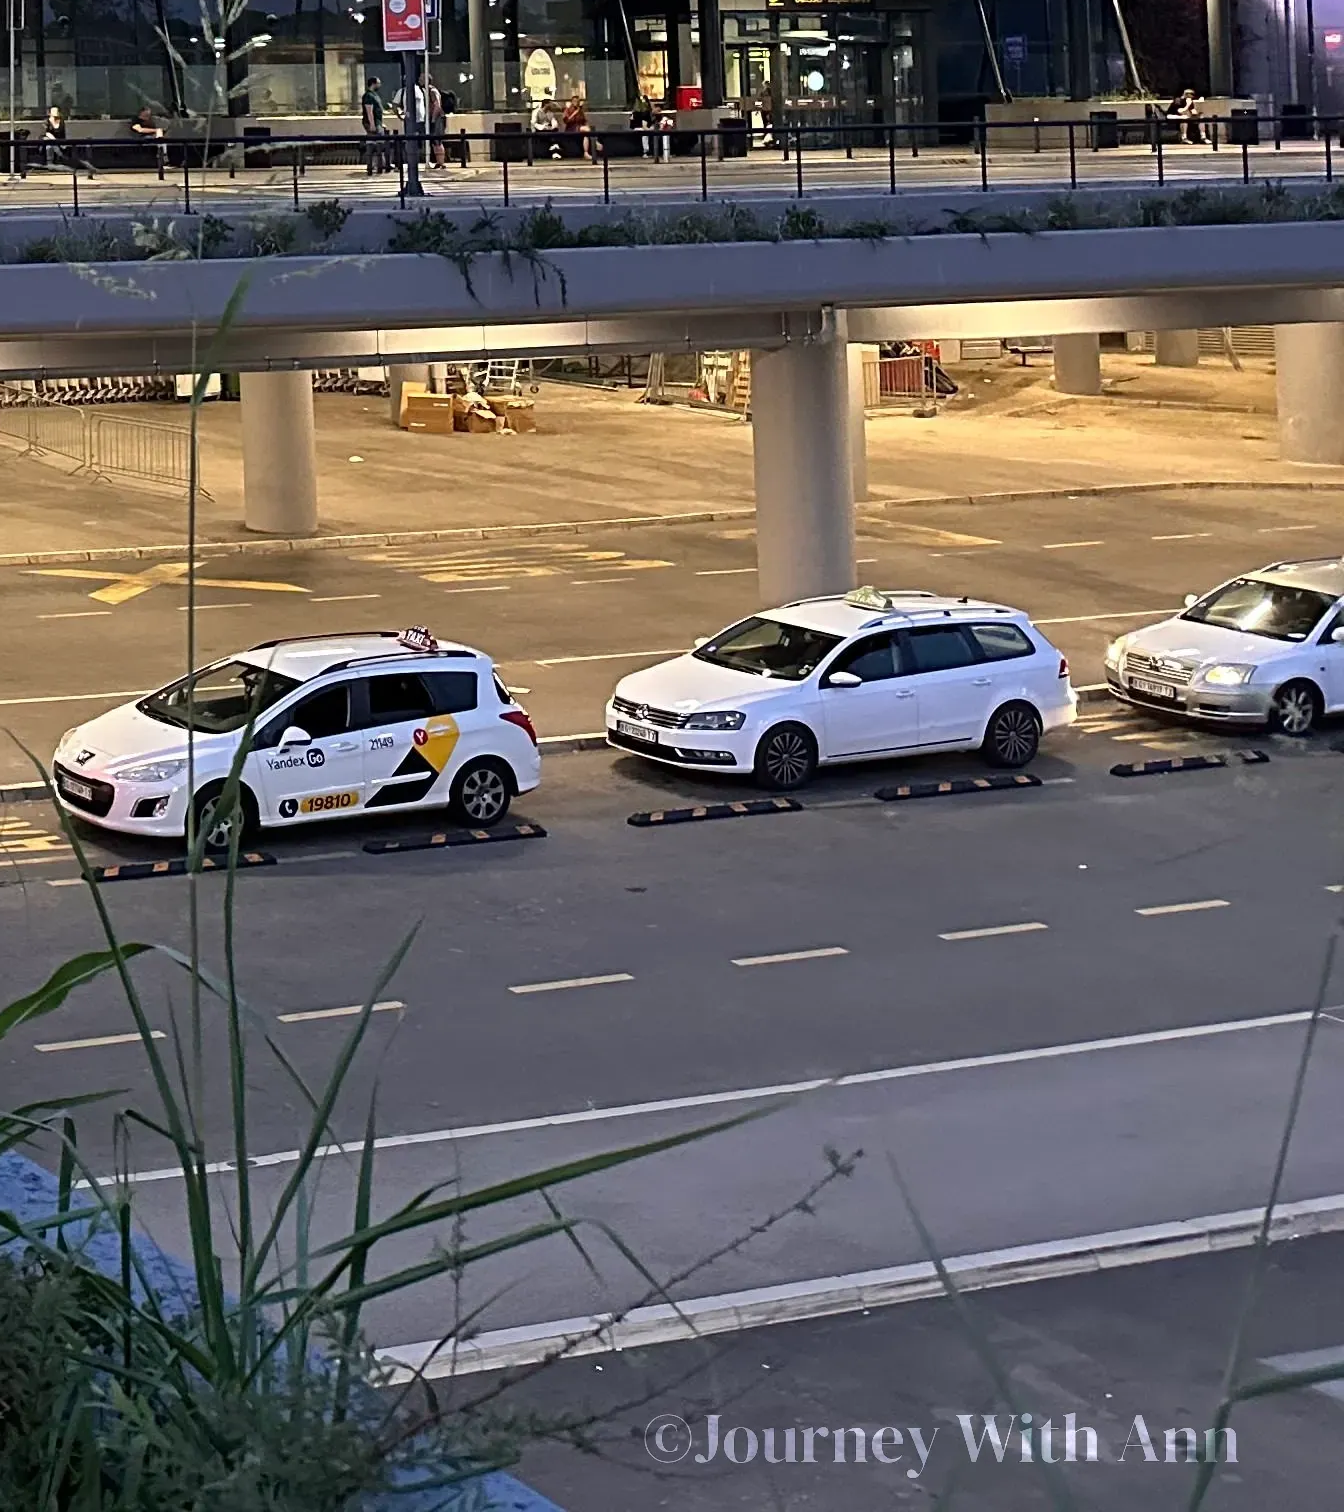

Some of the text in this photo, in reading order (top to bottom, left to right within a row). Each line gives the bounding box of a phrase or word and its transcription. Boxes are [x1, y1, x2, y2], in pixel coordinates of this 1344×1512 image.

[406, 629, 426, 645] TAXI
[368, 736, 395, 752] 21149
[266, 750, 325, 772] Yandex Go
[306, 792, 352, 813] 19810
